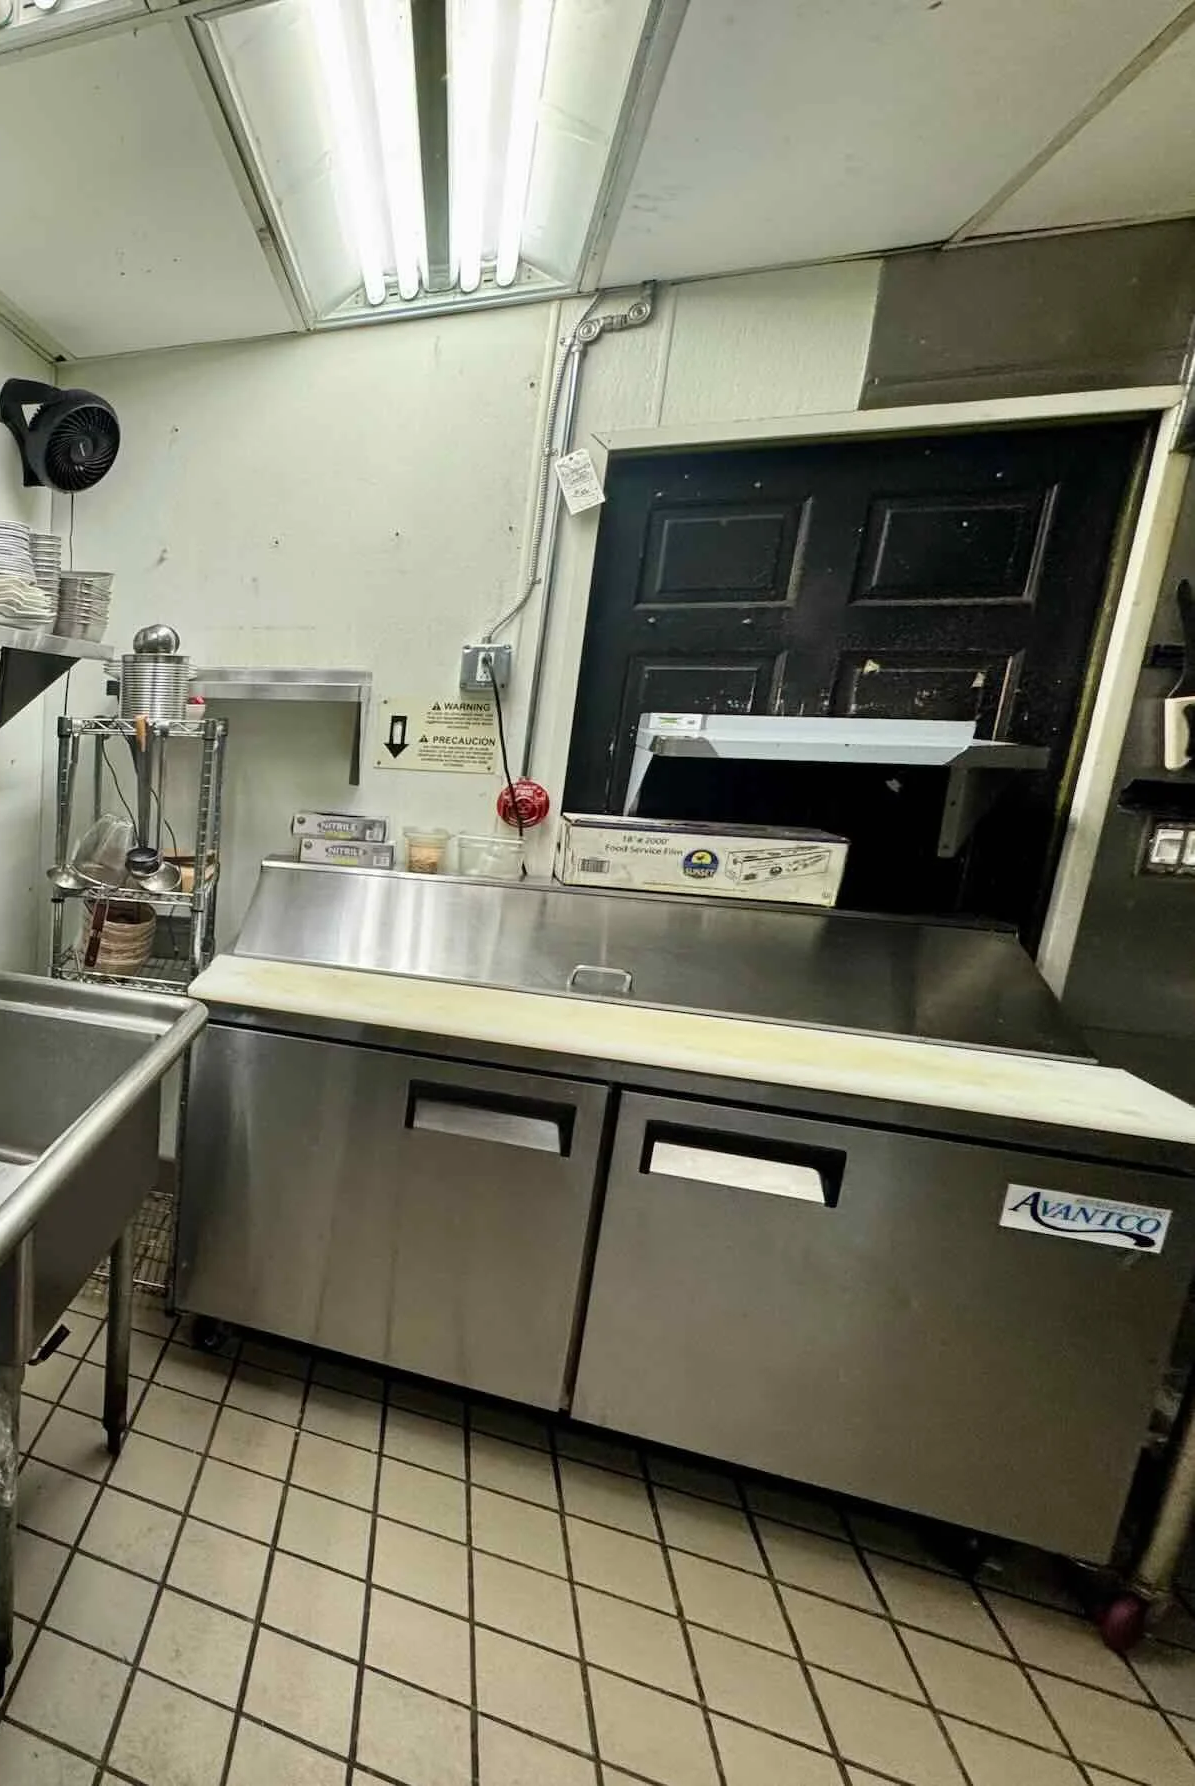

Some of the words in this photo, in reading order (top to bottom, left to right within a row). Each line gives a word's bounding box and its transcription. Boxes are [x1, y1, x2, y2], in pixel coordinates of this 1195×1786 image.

[444, 702, 491, 712] WARNING
[605, 843, 628, 853] Food
[630, 845, 662, 855] Service
[663, 848, 684, 857] Film
[1008, 1191, 1162, 1236] AVANTCO
